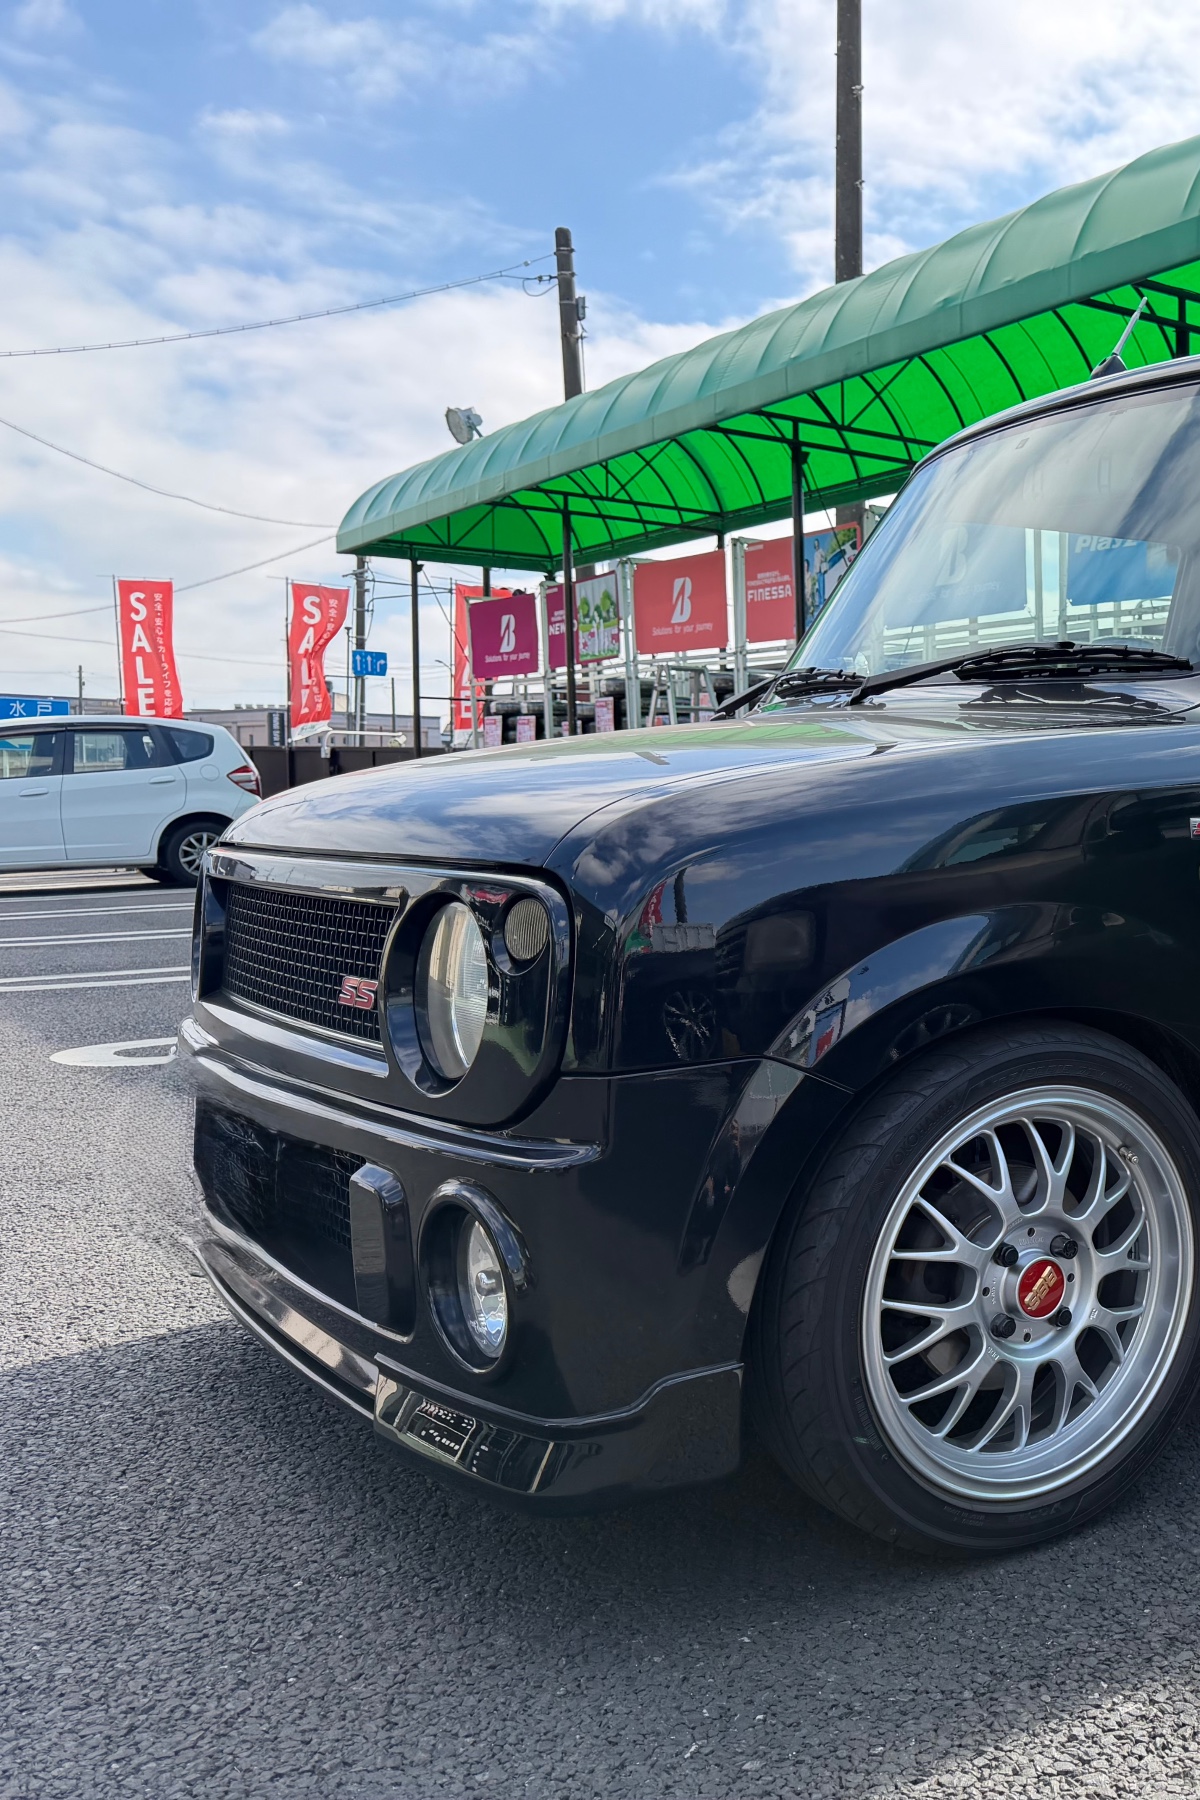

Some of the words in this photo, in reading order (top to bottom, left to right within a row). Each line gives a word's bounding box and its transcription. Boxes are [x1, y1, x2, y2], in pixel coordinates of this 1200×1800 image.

[747, 584, 793, 603] FINESSA
[129, 591, 156, 716] SALE
[9, 700, 52, 717] 水戸
[338, 976, 378, 1010] SS
[1024, 1266, 1058, 1311] BBS
